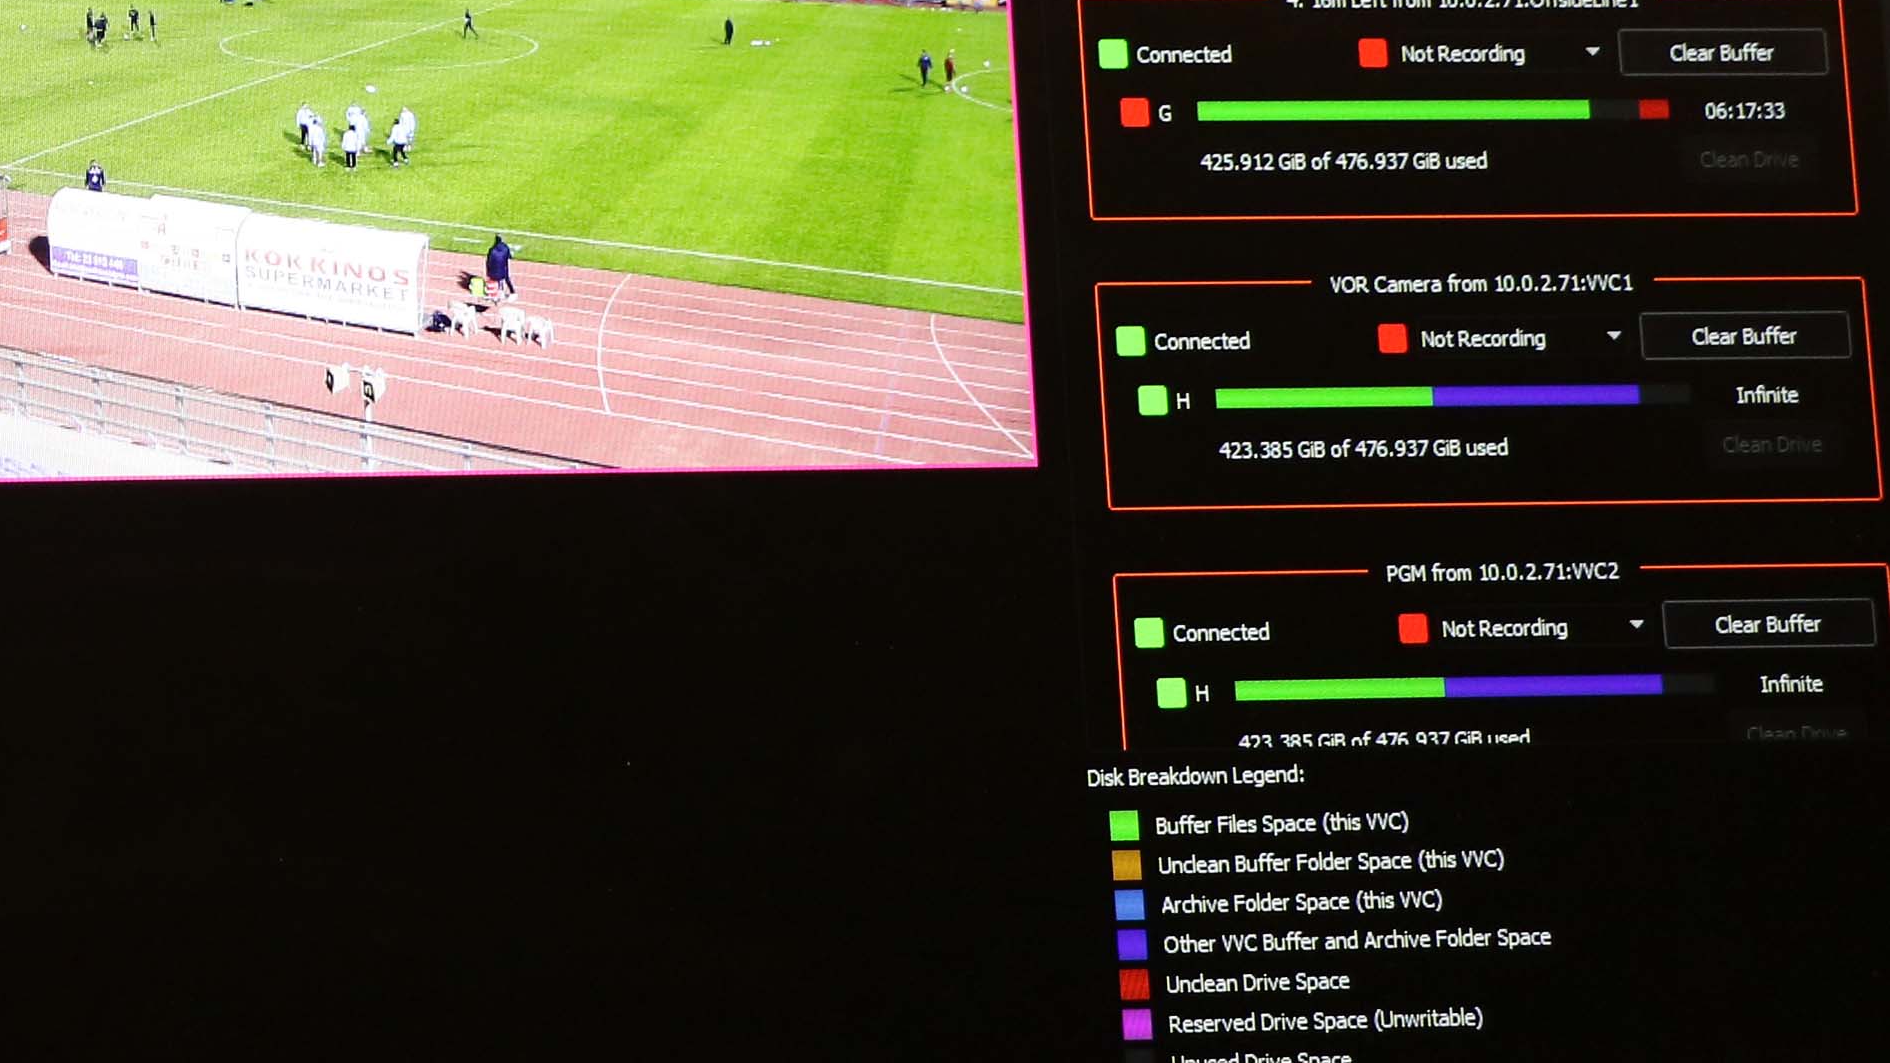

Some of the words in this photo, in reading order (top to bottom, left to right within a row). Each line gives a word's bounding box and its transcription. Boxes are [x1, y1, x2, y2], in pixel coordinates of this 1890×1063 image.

[1136, 44, 1233, 64] Connected
[1401, 45, 1435, 63] Not
[1437, 43, 1526, 66] Recording
[1669, 42, 1716, 62] Clear
[1719, 42, 1775, 62] Buffer
[1158, 104, 1172, 122] G
[1704, 101, 1786, 120] 06:17:33
[1200, 153, 1275, 171] 425.912
[1278, 152, 1307, 171] GiB
[1310, 150, 1332, 171] of
[1334, 152, 1409, 170] 476.937
[1412, 152, 1441, 170] GiB
[1445, 150, 1488, 170] used
[244, 247, 411, 286] KOKKINOS
[244, 264, 409, 303] SUPERMARKET
[1329, 275, 1370, 294] VOR
[1373, 275, 1443, 294] Camera
[1446, 273, 1488, 293] from
[1494, 273, 1634, 293] 10.0.2.71:VVC1
[1176, 392, 1191, 410] H
[1386, 564, 1427, 583] PGM
[1430, 562, 1473, 582] from
[1479, 561, 1620, 582] 10.0.2.71:VVC2
[1195, 684, 1210, 703] H
[1087, 766, 1125, 787] Disk
[1128, 765, 1228, 787] Breakdown
[1232, 763, 1305, 788] Legend:
[1155, 814, 1212, 835] Buffer
[1217, 813, 1258, 834] Files
[1261, 814, 1317, 837] Space
[1322, 811, 1362, 836] (this
[1365, 810, 1409, 834] VVC)
[1163, 933, 1217, 954] Other
[1221, 933, 1258, 953] VVC
[1262, 930, 1319, 952] Buffer
[1324, 929, 1359, 950] and
[1364, 928, 1431, 949] Archive
[1435, 927, 1492, 948] Folder
[1496, 928, 1552, 950] Space
[1166, 972, 1239, 994] Unclean
[1242, 973, 1291, 992] Drive
[1295, 972, 1351, 994] Space
[1168, 1011, 1256, 1034] Reserved
[1260, 1012, 1309, 1032] Drive
[1313, 1011, 1369, 1034] Space
[1373, 1006, 1484, 1032] (Unwritable)
